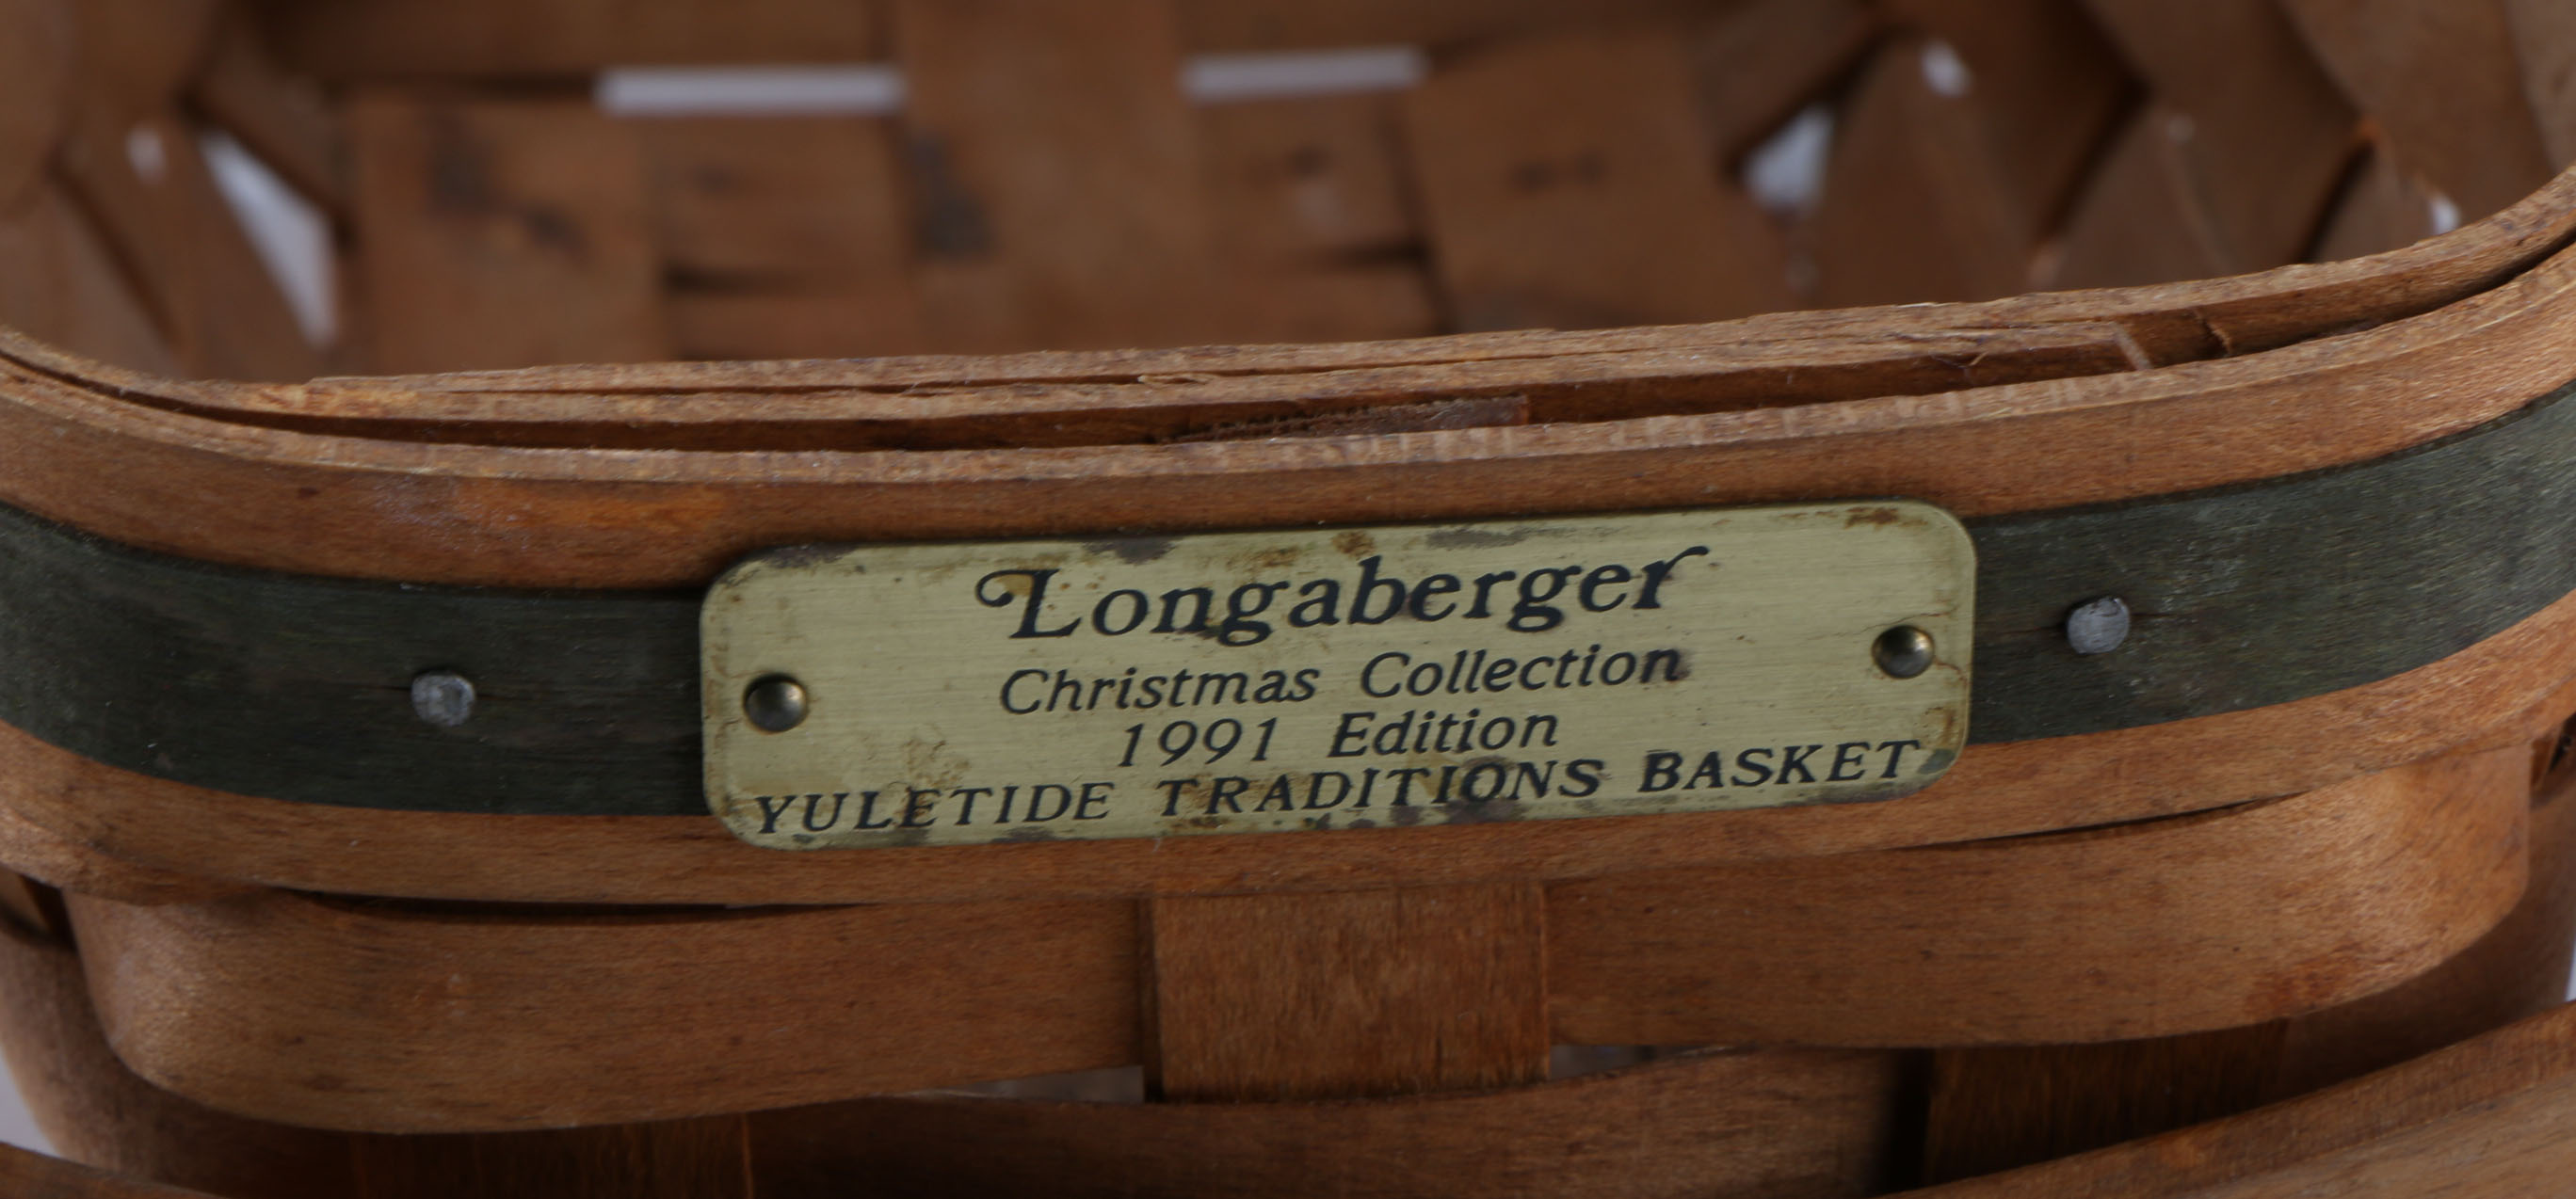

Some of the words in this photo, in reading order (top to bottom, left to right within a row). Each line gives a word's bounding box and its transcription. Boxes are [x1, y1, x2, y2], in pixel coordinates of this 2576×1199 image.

[974, 546, 1710, 647] Longaberger
[1000, 666, 1321, 715] Christmas
[1360, 644, 1683, 698] Collection
[1119, 716, 1280, 767] 1991
[1328, 708, 1559, 758] Edition
[754, 781, 1116, 835] YULETIDE
[1156, 759, 1605, 817] TRADITIONS
[1637, 739, 1921, 793] BASKET
